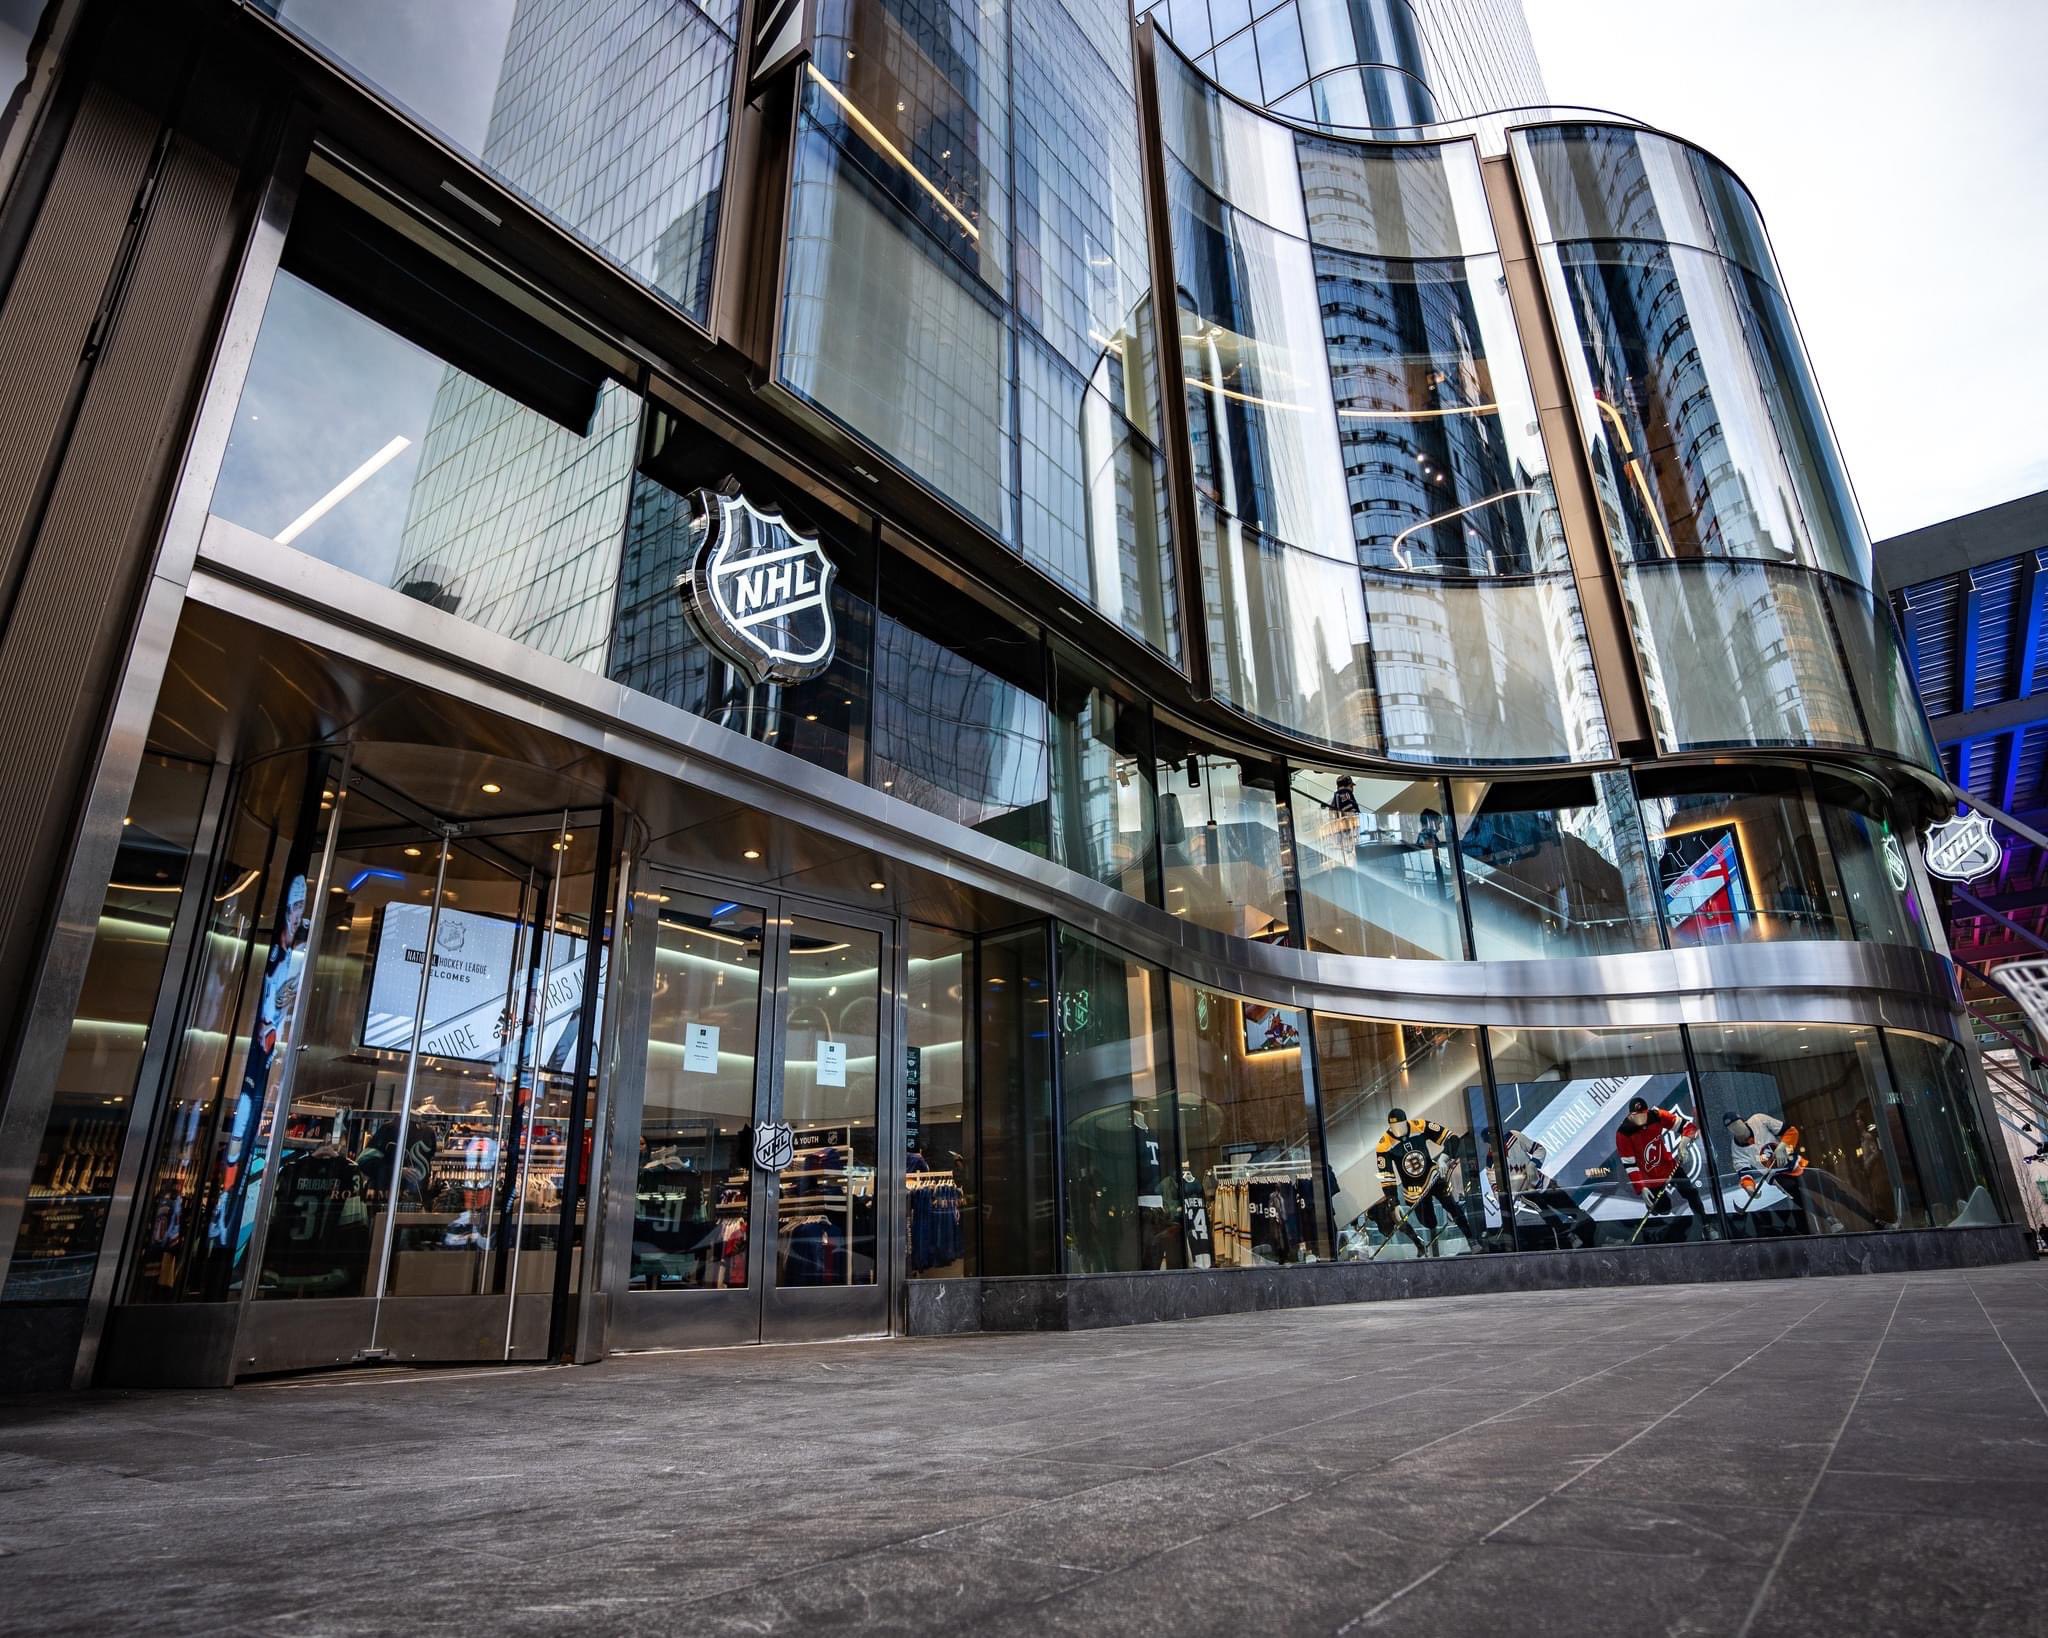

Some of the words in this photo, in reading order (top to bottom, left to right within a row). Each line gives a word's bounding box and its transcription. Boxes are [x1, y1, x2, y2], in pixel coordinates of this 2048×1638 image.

[735, 560, 816, 614] NHL
[1941, 828, 1982, 868] NHL
[439, 957, 464, 971] HOCKEY
[465, 961, 488, 975] LEAGUE
[799, 1135, 819, 1144] YOUTH
[1537, 1098, 1596, 1157] NATIONAL
[762, 1135, 788, 1161] NHL
